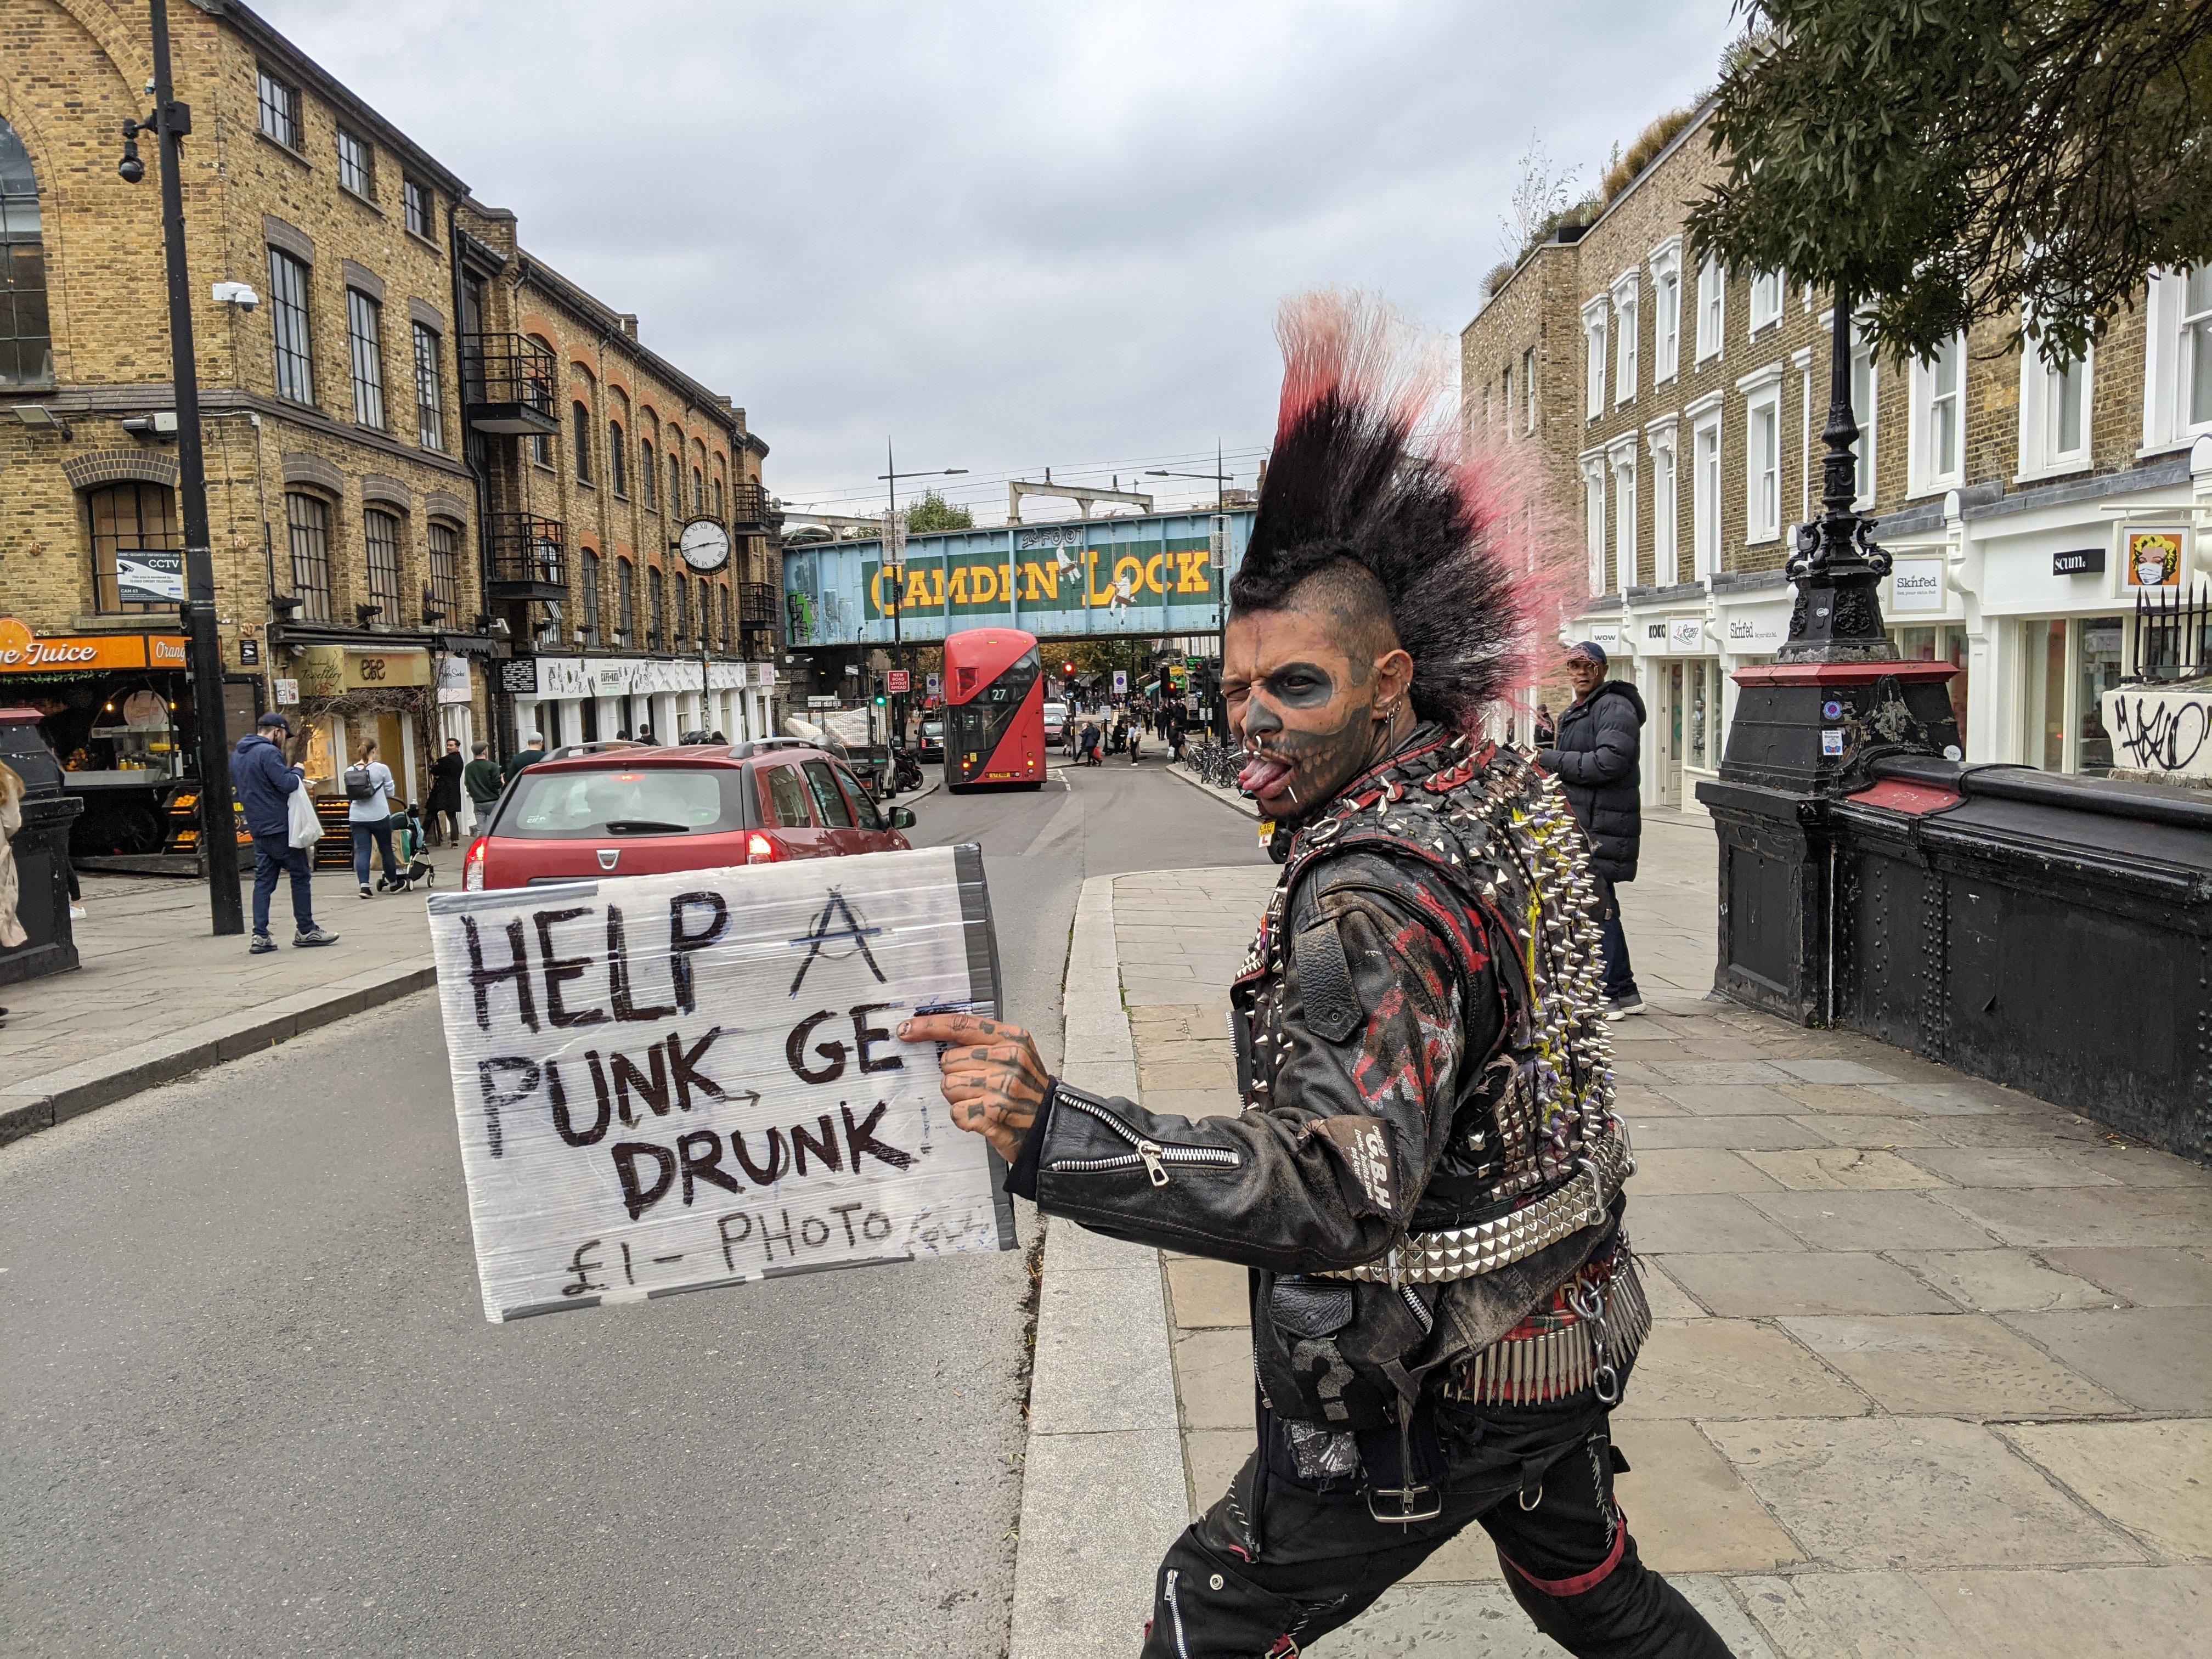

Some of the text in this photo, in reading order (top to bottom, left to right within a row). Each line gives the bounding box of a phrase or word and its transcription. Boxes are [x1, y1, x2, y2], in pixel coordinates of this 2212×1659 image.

[686, 516, 723, 525] CAMDEN LOCK
[148, 560, 179, 568] CCTV
[871, 550, 1210, 616] CAMDEN LOCK
[25, 644, 98, 665] Juice
[992, 689, 1007, 701] 27
[1262, 836, 1268, 844] L
[460, 883, 886, 1035] HELP A
[478, 1025, 743, 1159] PUNK
[1372, 1125, 1389, 1157] CHARGED
[561, 1238, 634, 1296] £1
[717, 1202, 893, 1272] PHOTO
